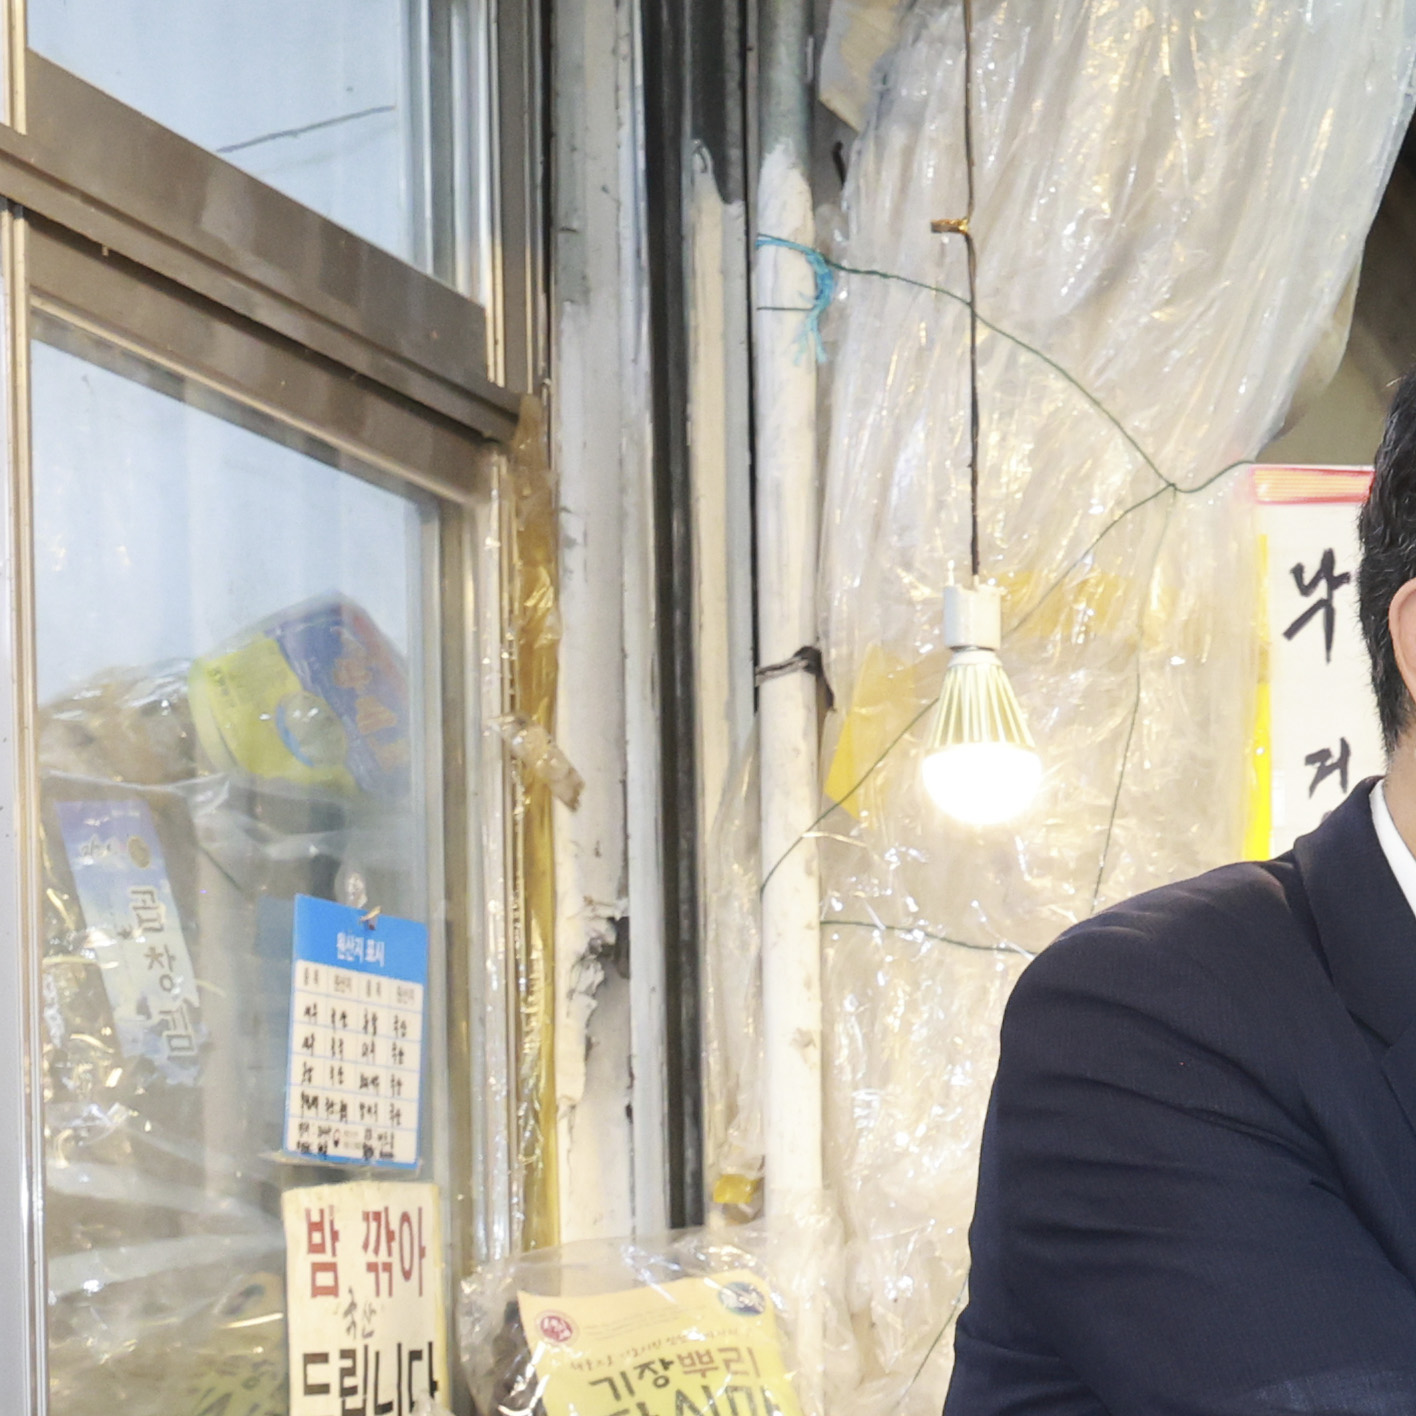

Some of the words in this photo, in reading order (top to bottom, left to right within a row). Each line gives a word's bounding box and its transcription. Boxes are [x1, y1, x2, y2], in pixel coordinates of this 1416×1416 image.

[336, 931, 364, 963] 원산지
[366, 938, 385, 968] 표시
[305, 1205, 340, 1299] 밤
[362, 1206, 426, 1299] 깎아
